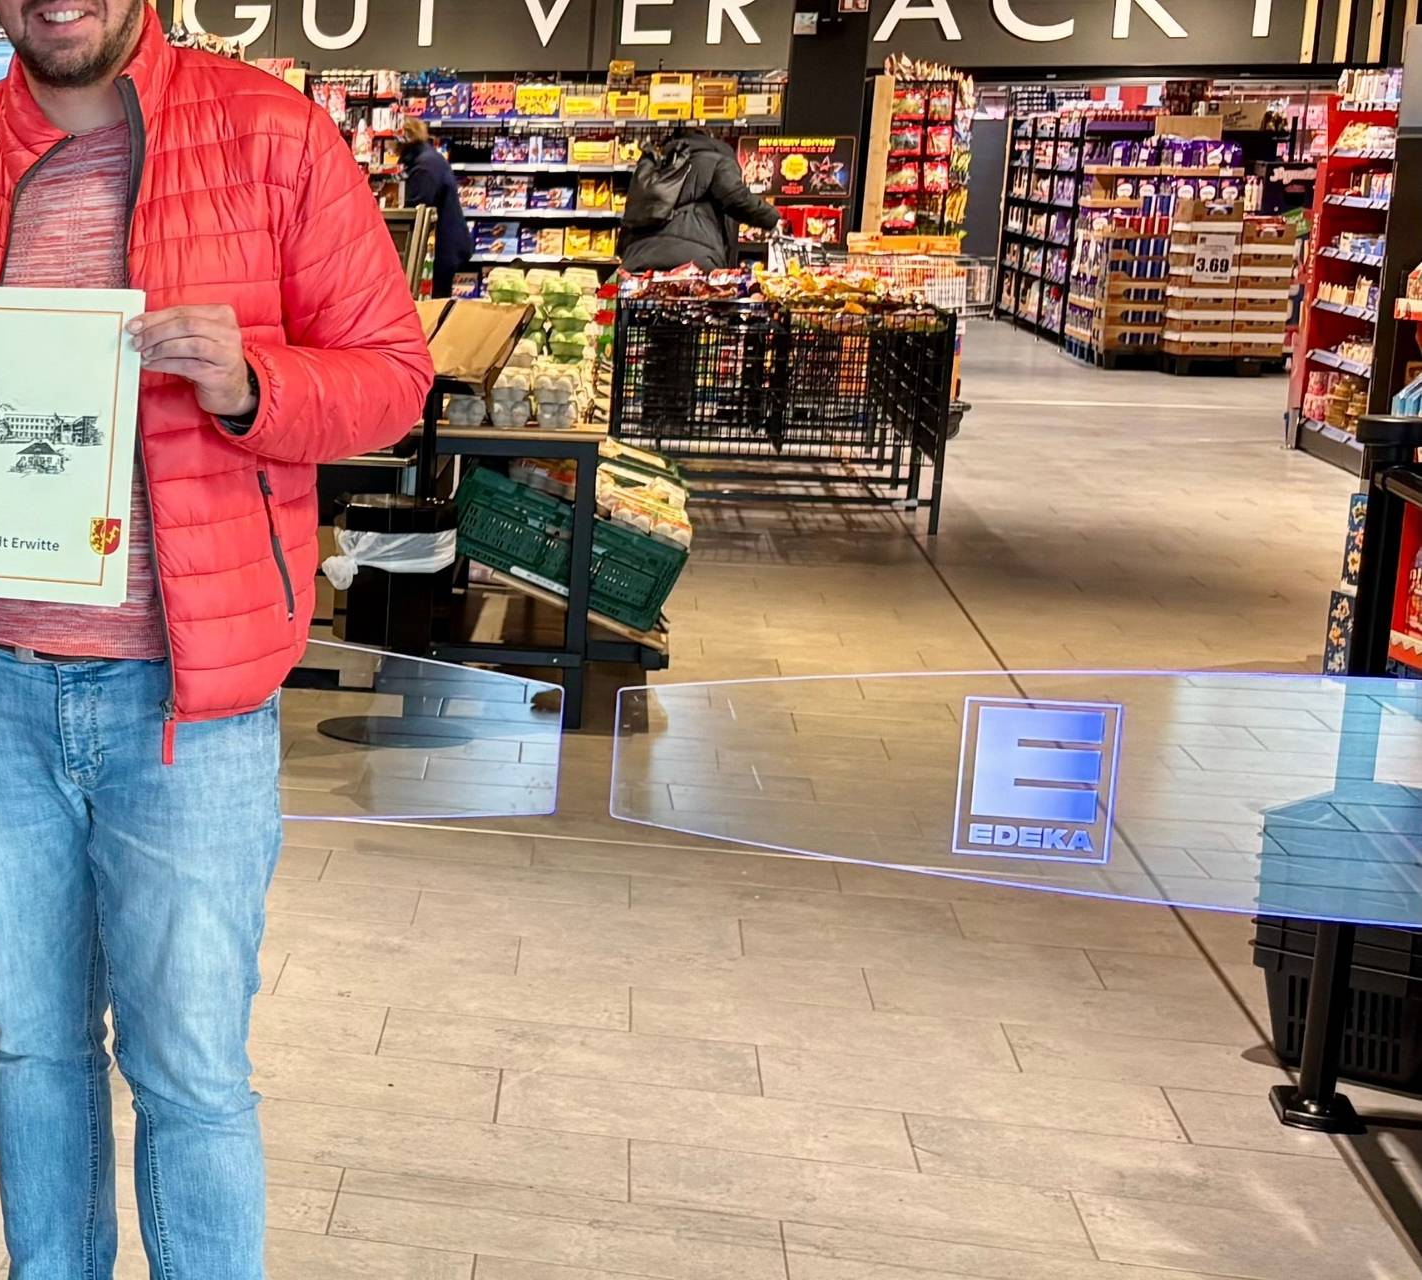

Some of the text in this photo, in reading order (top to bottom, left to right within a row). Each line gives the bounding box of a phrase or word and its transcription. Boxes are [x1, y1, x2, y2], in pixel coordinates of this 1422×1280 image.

[1196, 257, 1230, 273] 3.69
[11, 537, 60, 552] Erwitte
[968, 823, 1094, 852] EDEKA
